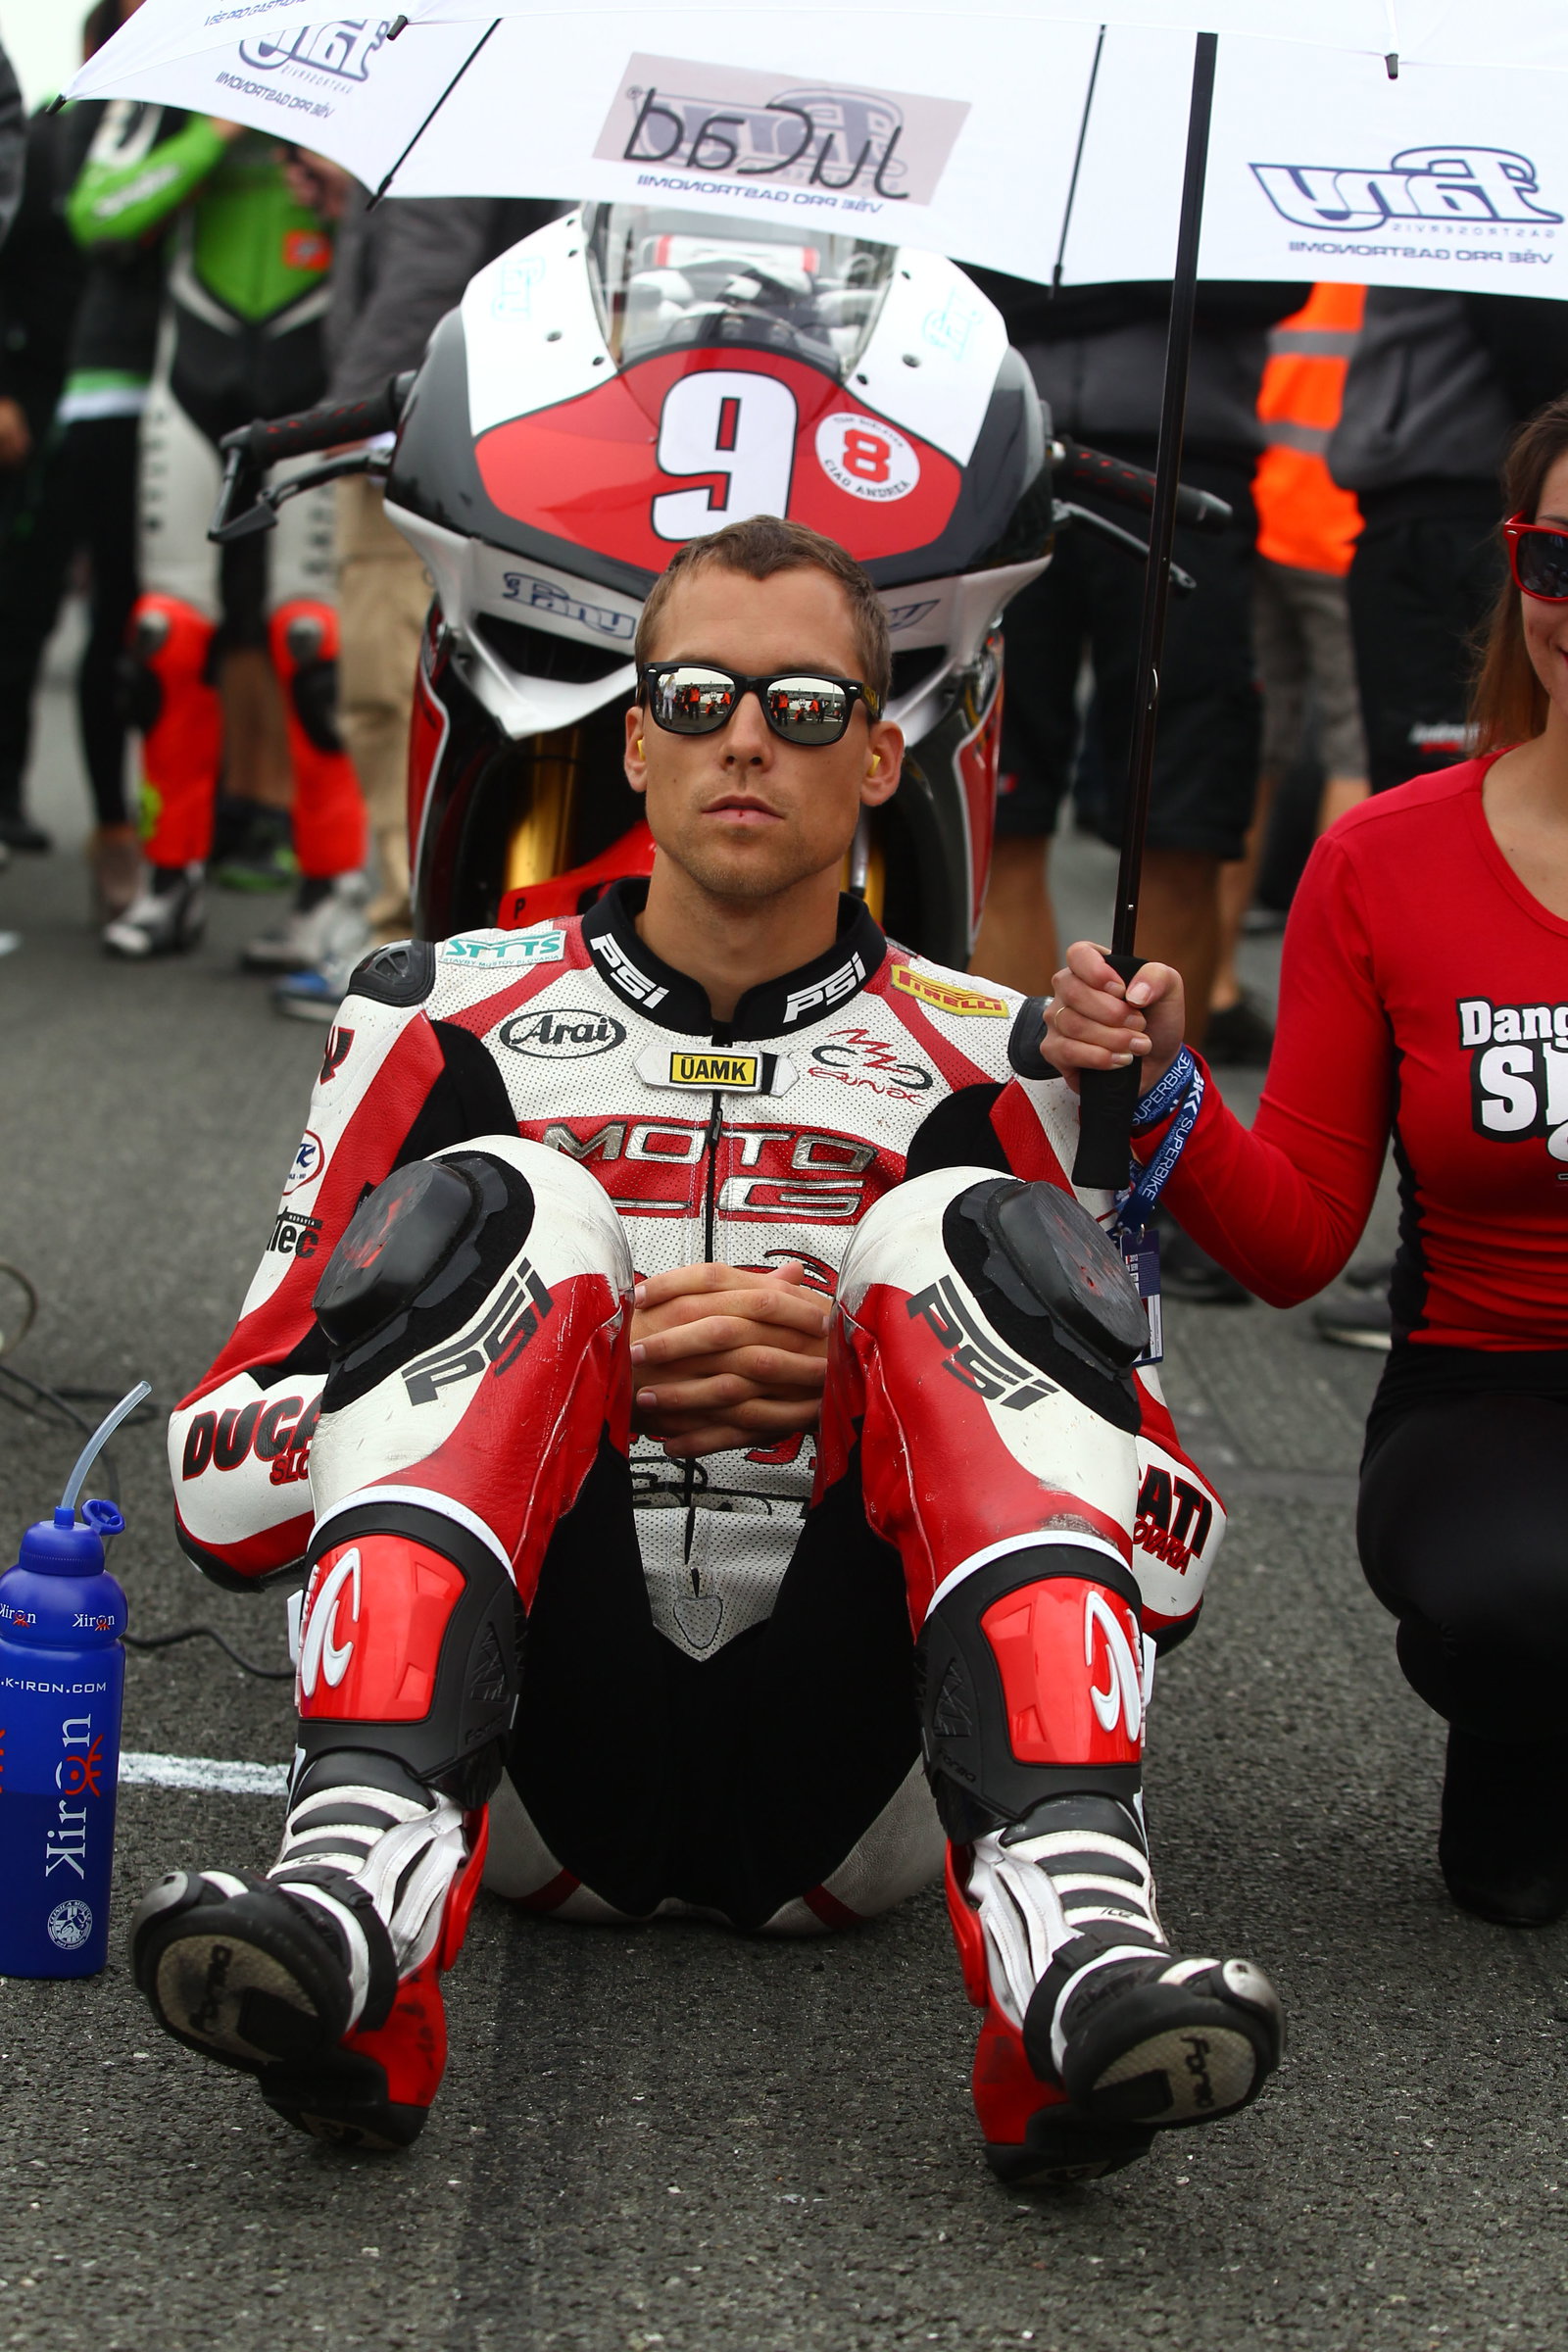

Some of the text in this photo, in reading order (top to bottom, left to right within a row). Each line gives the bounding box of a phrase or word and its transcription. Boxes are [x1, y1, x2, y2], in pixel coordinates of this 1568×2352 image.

[651, 368, 798, 541] 9
[825, 459, 910, 498] CIAO ANDREA
[843, 428, 891, 483] 8
[899, 969, 1003, 1010] PIRELLI
[510, 1015, 612, 1045] Arai
[543, 1120, 879, 1173] MOTO
[1142, 1117, 1194, 1200] SUPERBIKE
[1135, 1464, 1212, 1559] ATI
